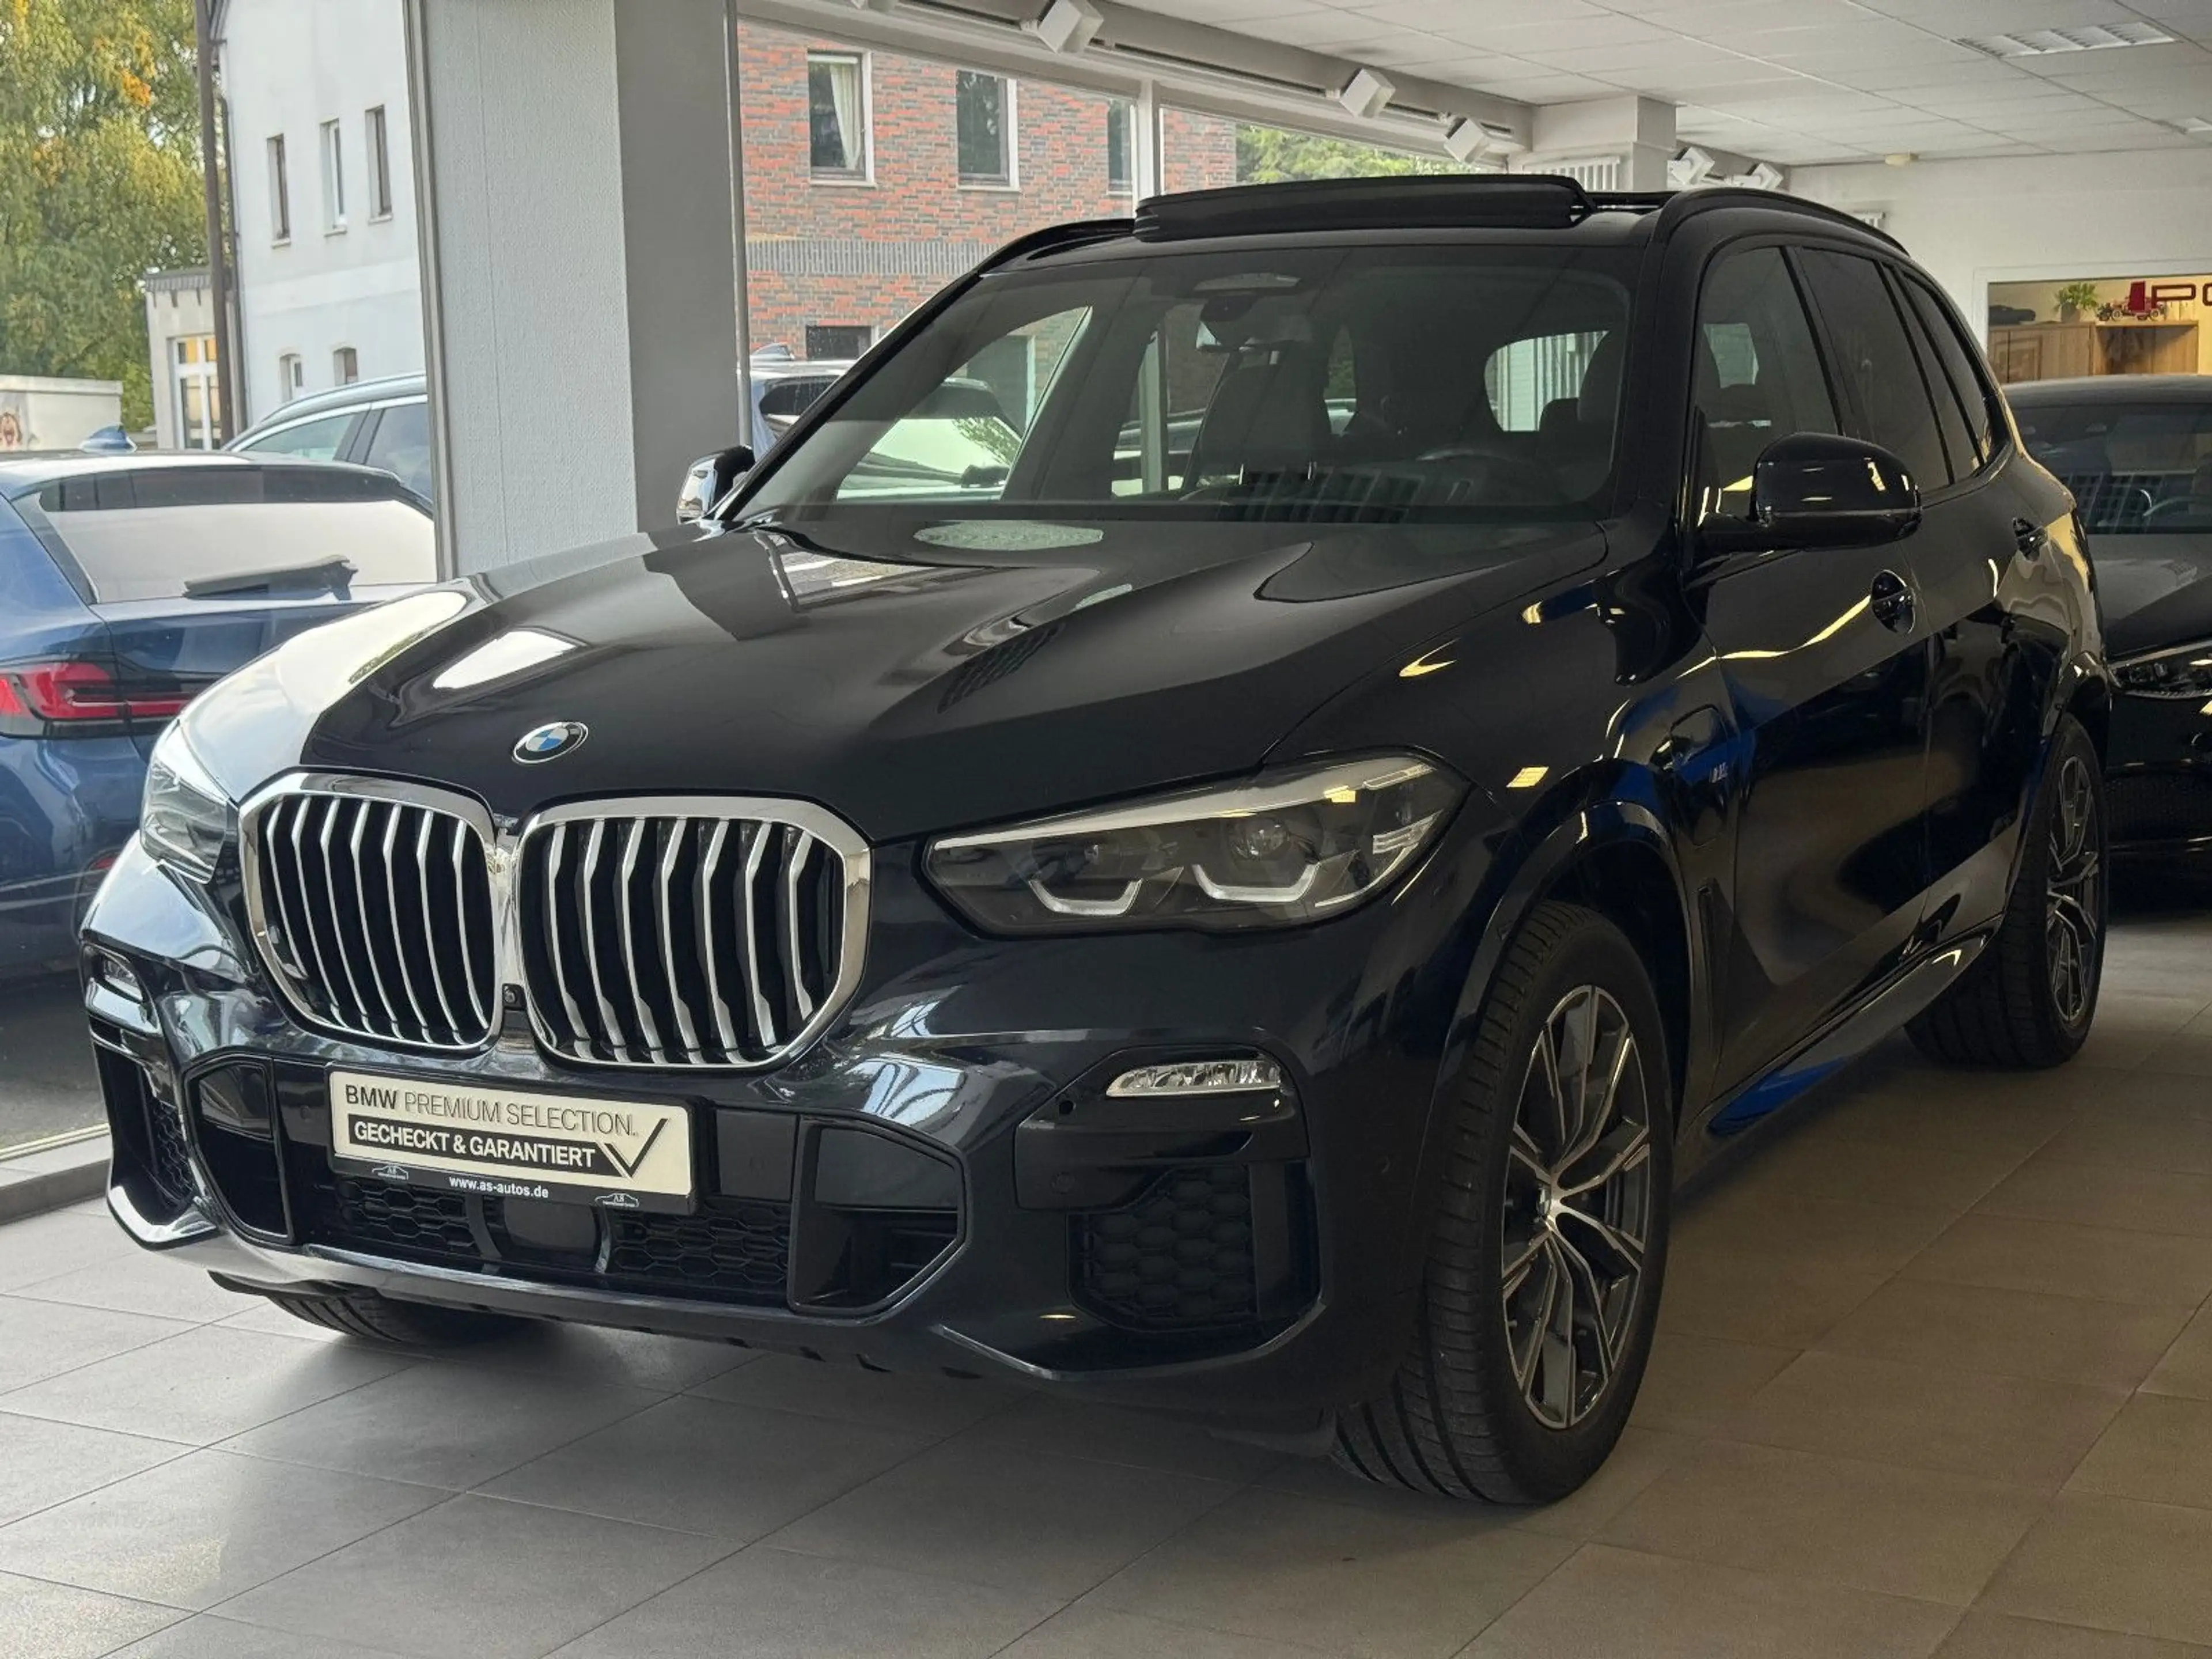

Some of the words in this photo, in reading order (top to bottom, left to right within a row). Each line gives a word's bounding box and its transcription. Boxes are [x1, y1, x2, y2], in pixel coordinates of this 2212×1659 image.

[2152, 283, 2212, 309] P
[346, 1085, 397, 1109] BMW
[404, 1091, 501, 1123] PREMIUM
[354, 1121, 450, 1152] GECHECKT
[453, 1135, 467, 1154] &
[469, 1136, 596, 1168] GARANTIERT
[449, 1176, 549, 1198] www.as-autos.de
